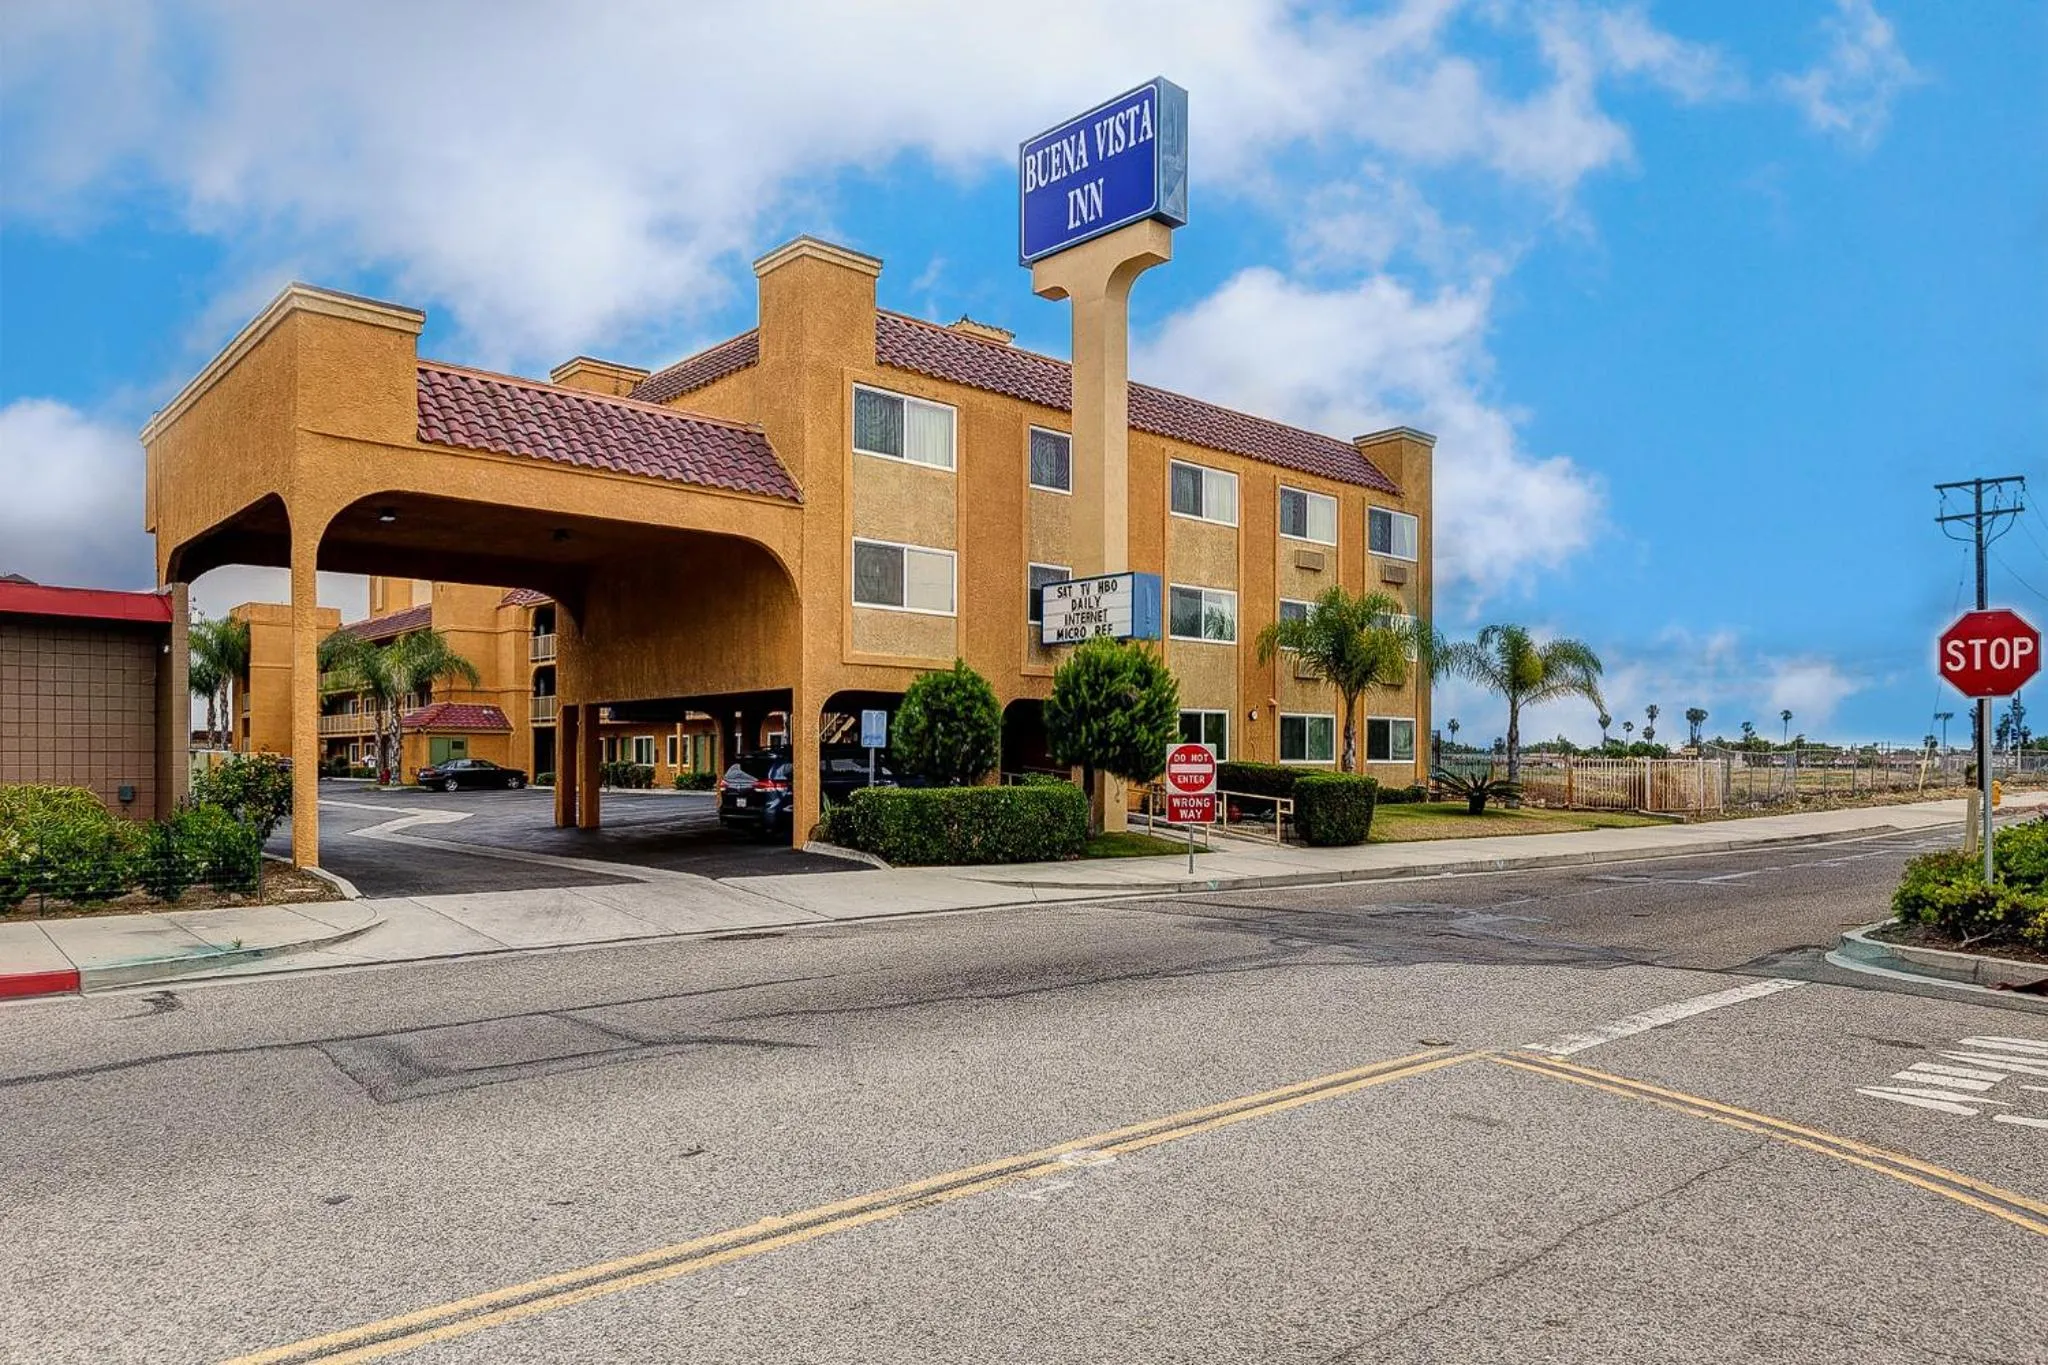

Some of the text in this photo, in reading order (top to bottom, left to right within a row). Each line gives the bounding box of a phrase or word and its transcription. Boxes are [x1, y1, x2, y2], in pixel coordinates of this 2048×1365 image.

[1025, 99, 1154, 194] BUENA VISTA
[1067, 178, 1104, 230] INN
[1057, 579, 1118, 598] SAT TV HBO
[1071, 597, 1101, 612] DAILY
[1064, 609, 1108, 626] INTERNET
[1056, 626, 1087, 641] MICRO
[1945, 637, 2034, 672] STOP
[1174, 753, 1209, 762] DO NOT
[1178, 775, 1205, 784] ENTER
[1172, 797, 1210, 808] WRONG
[1179, 809, 1203, 819] WAY
